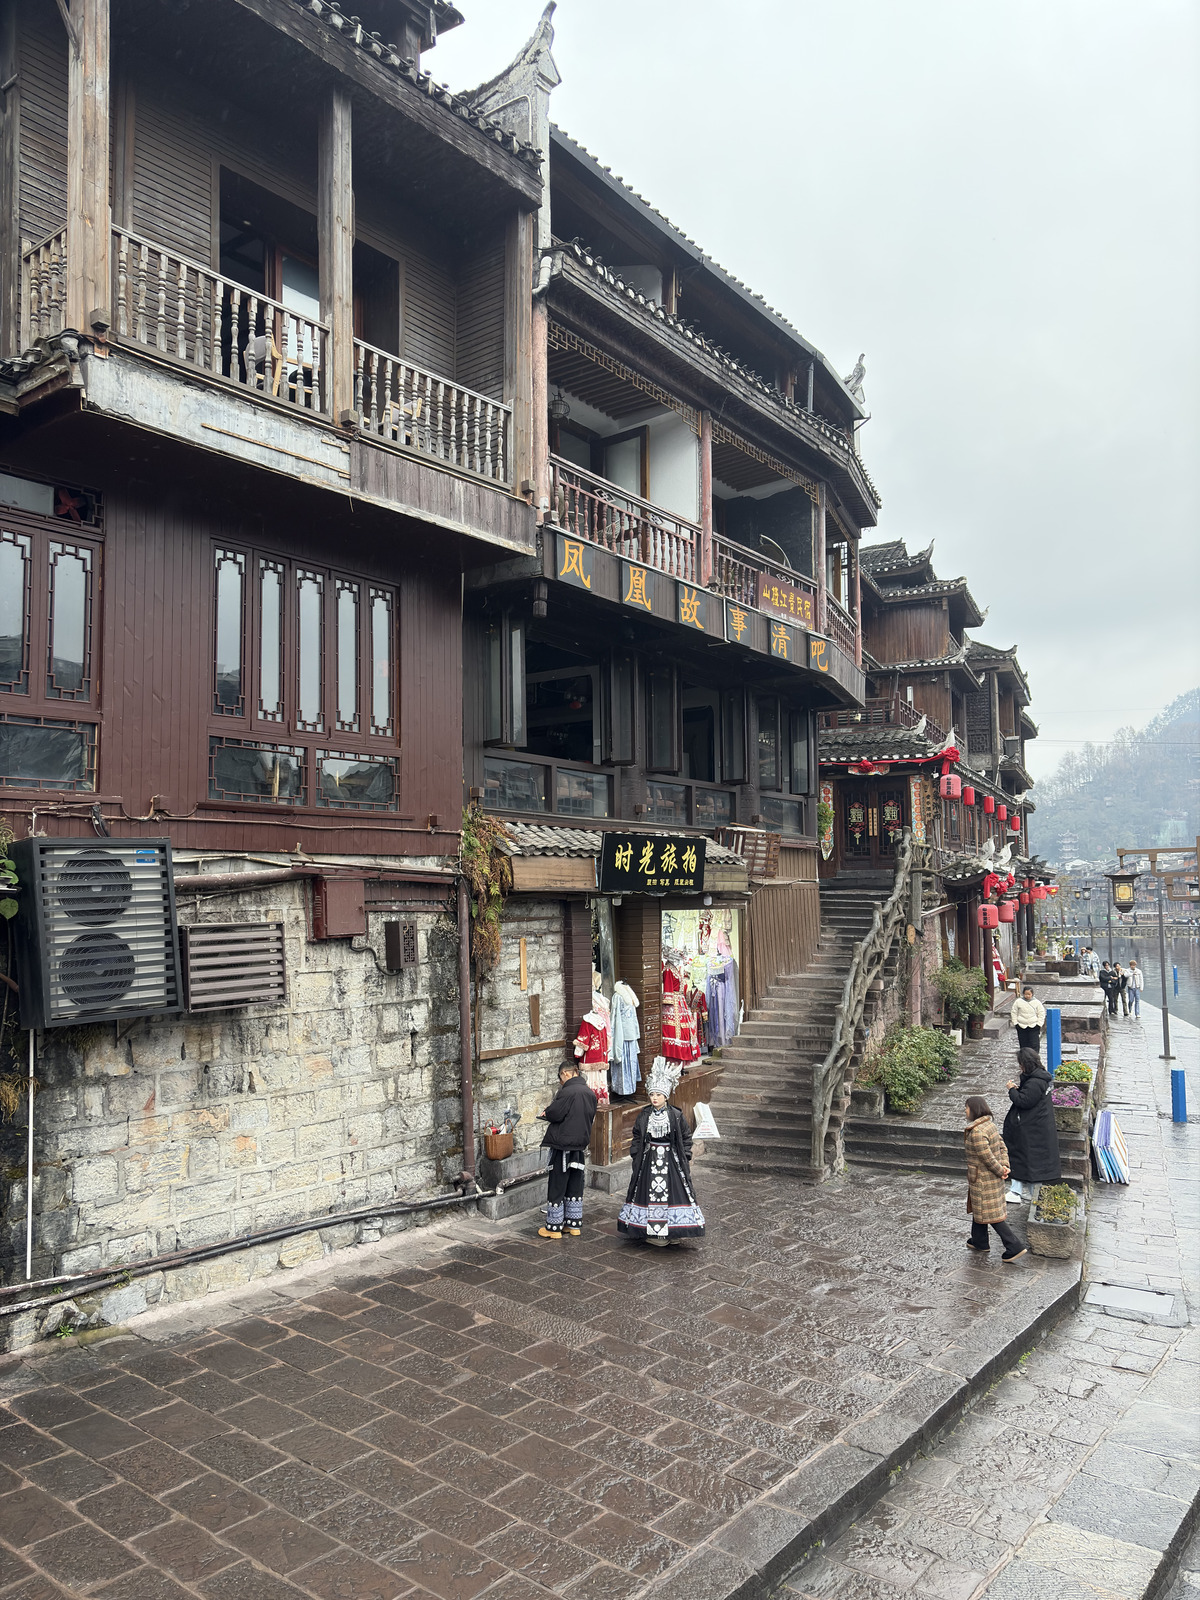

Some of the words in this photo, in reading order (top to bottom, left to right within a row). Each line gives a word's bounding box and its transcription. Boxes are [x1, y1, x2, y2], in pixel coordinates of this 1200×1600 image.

[560, 539, 828, 672] 凤凰故事清吧
[615, 840, 697, 875] 时光旅拍
